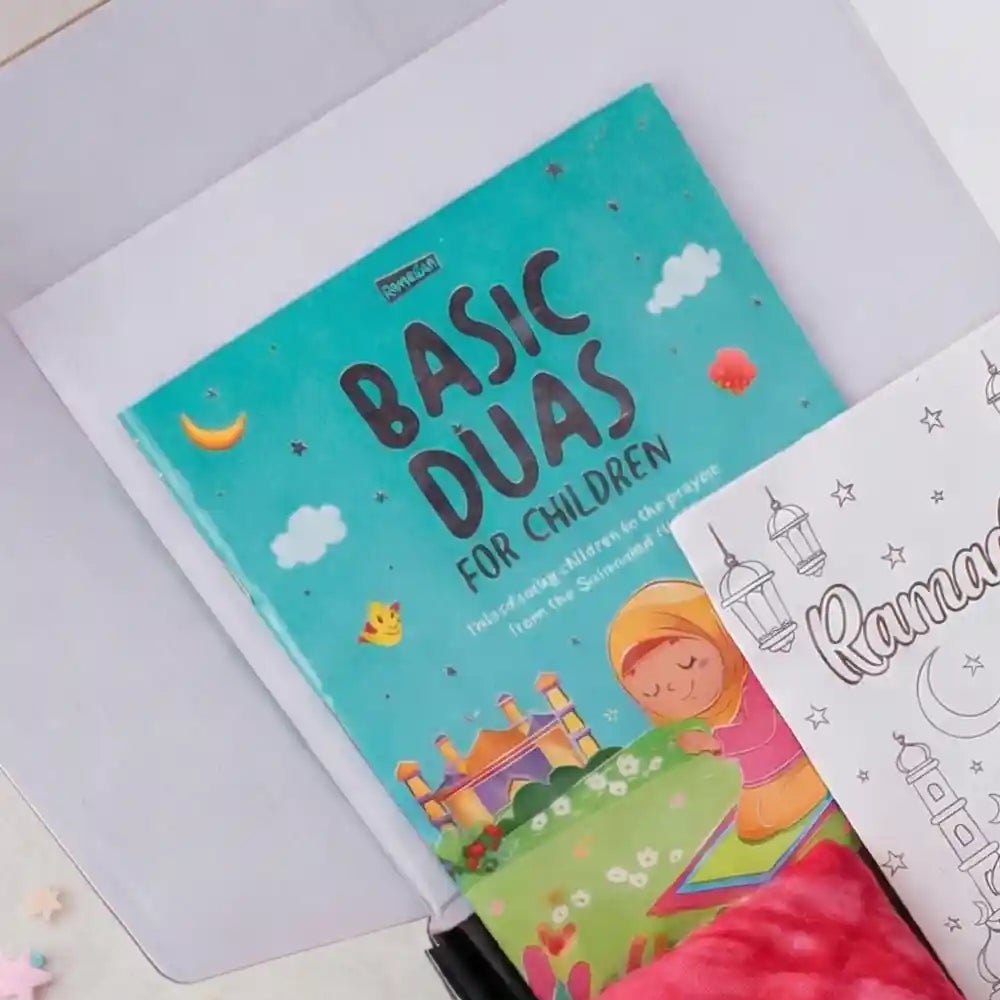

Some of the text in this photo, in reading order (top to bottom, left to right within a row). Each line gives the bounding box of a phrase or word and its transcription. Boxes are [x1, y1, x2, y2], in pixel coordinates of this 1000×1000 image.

[340, 249, 590, 449] BASIC
[408, 339, 636, 539] DUAS
[456, 434, 672, 594] FOR CHILDREN
